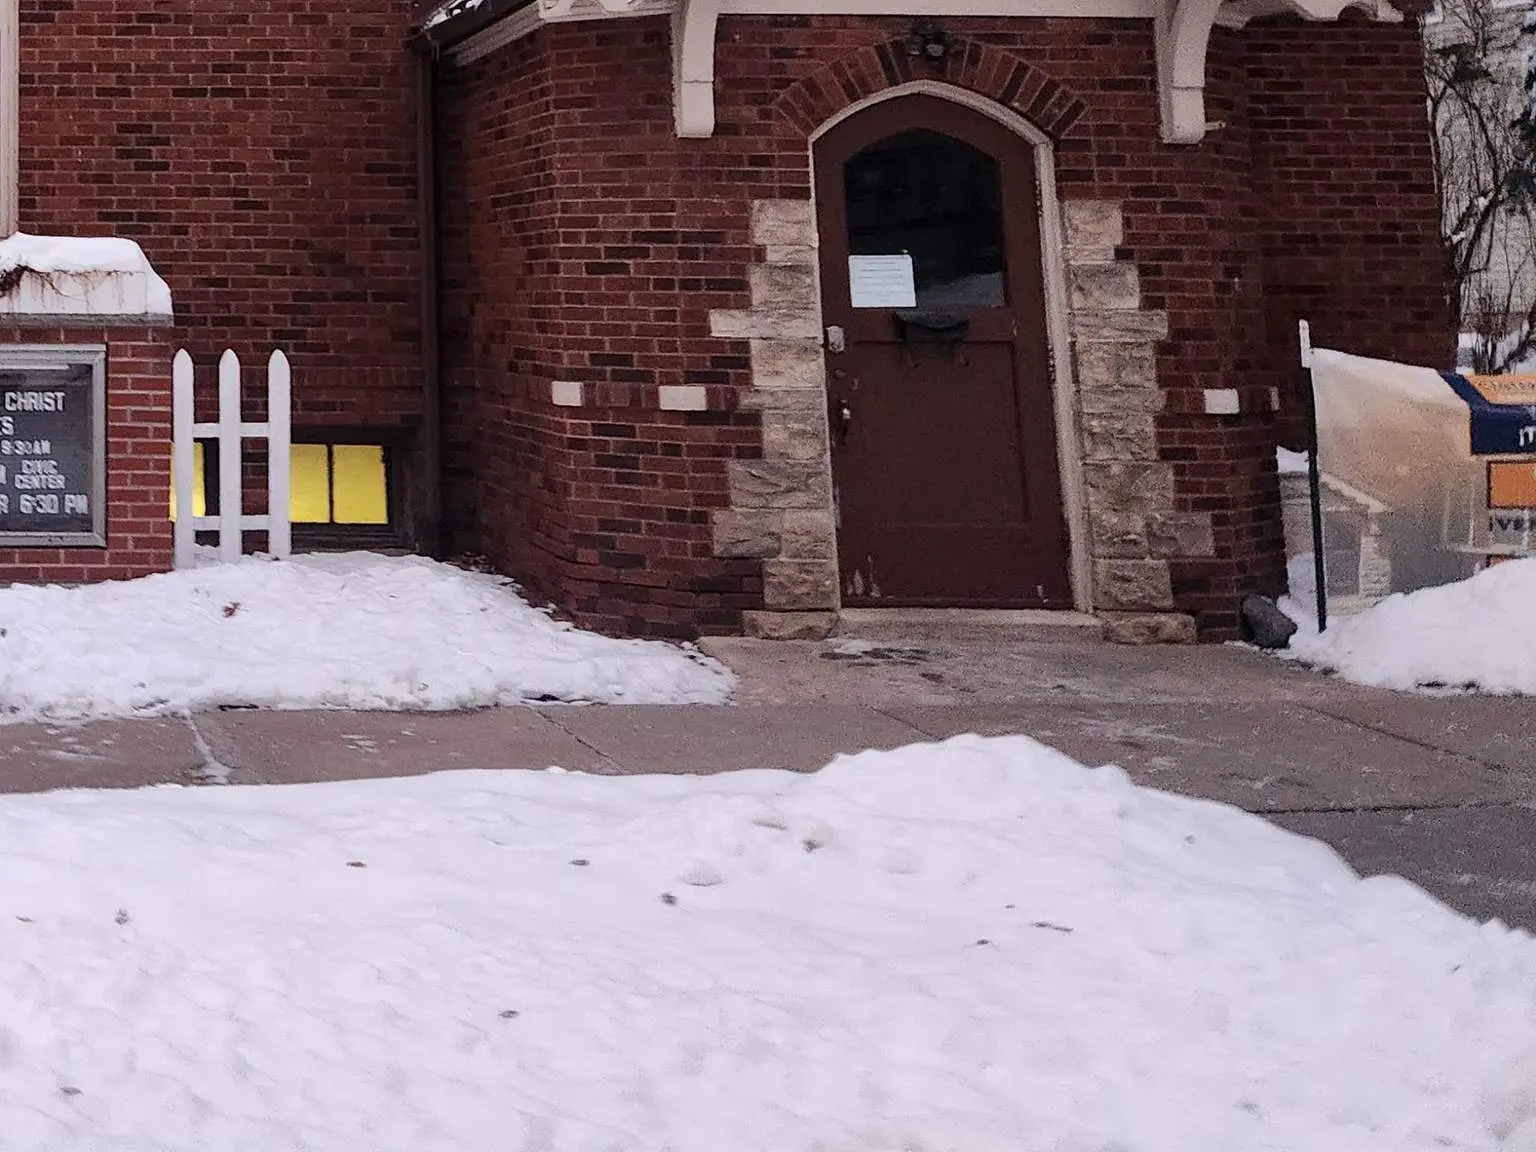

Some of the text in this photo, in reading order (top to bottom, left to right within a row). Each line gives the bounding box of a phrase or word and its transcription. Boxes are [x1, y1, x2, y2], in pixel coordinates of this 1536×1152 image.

[5, 391, 65, 412] CHRIST
[21, 459, 58, 475] CIVIC
[15, 473, 65, 490] CENTER
[19, 494, 59, 514] 6:30
[64, 494, 88, 514] PM
